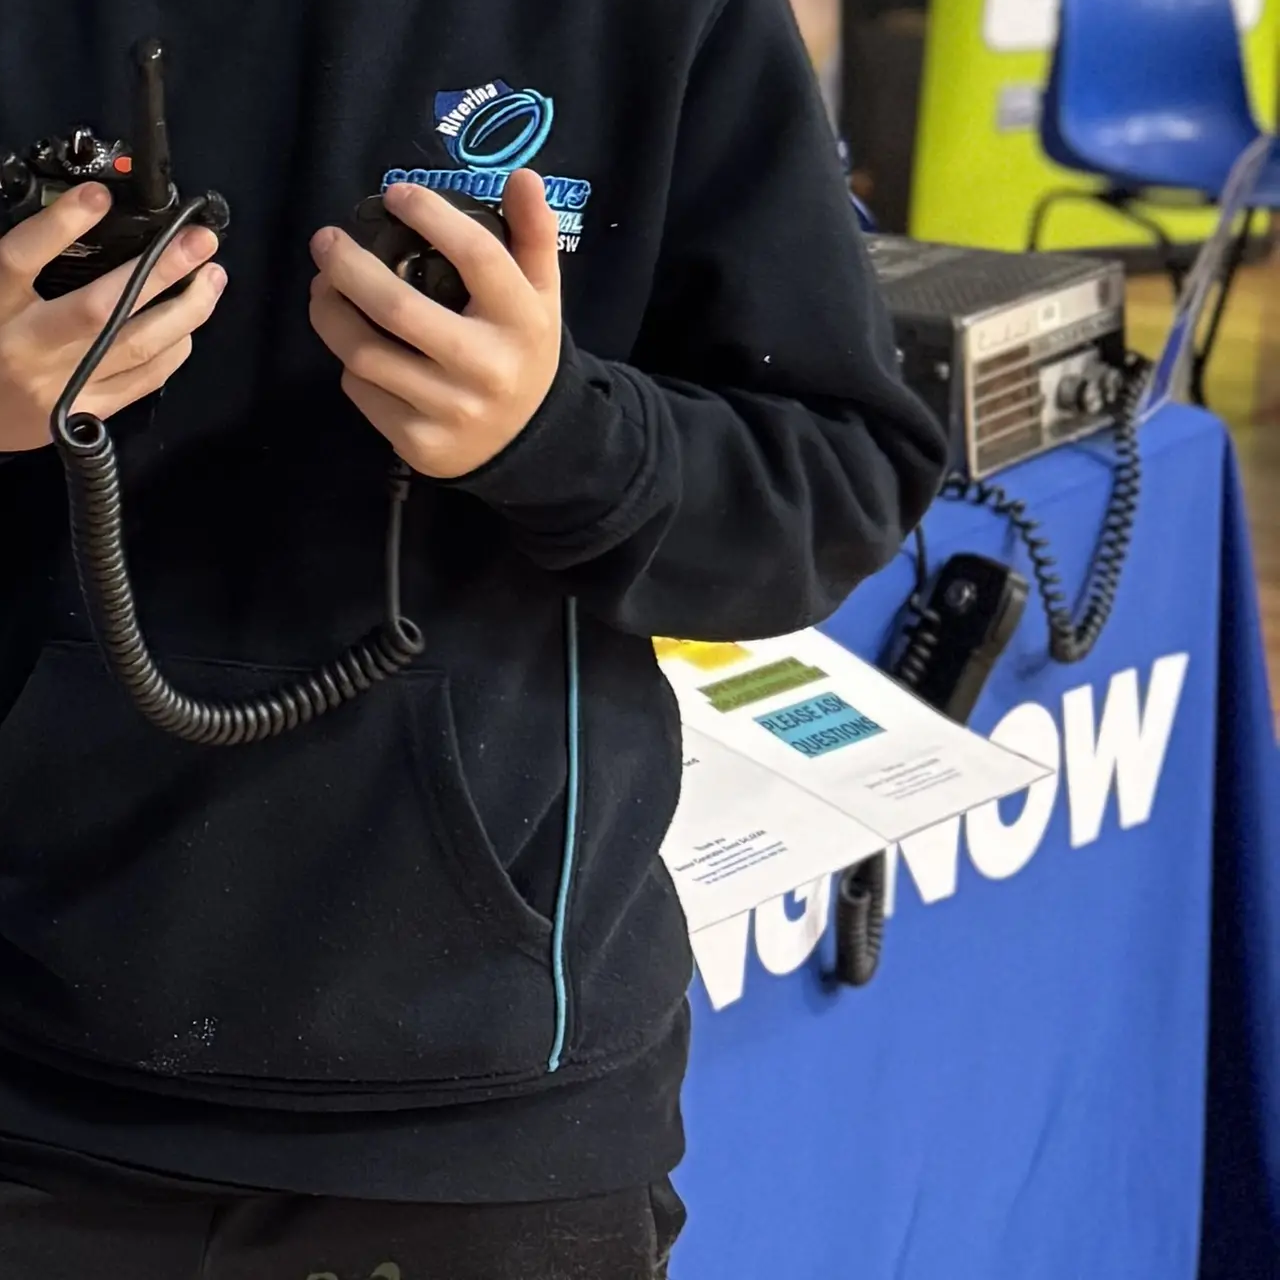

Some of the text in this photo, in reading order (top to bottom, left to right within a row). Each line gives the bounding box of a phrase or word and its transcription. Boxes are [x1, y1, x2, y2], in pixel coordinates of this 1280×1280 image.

[435, 83, 499, 138] Riverina
[380, 168, 592, 210] SCHOOLOYS
[556, 234, 582, 253] SW
[758, 694, 852, 733] PLEASE ASK
[791, 714, 883, 758] QUESTIONS
